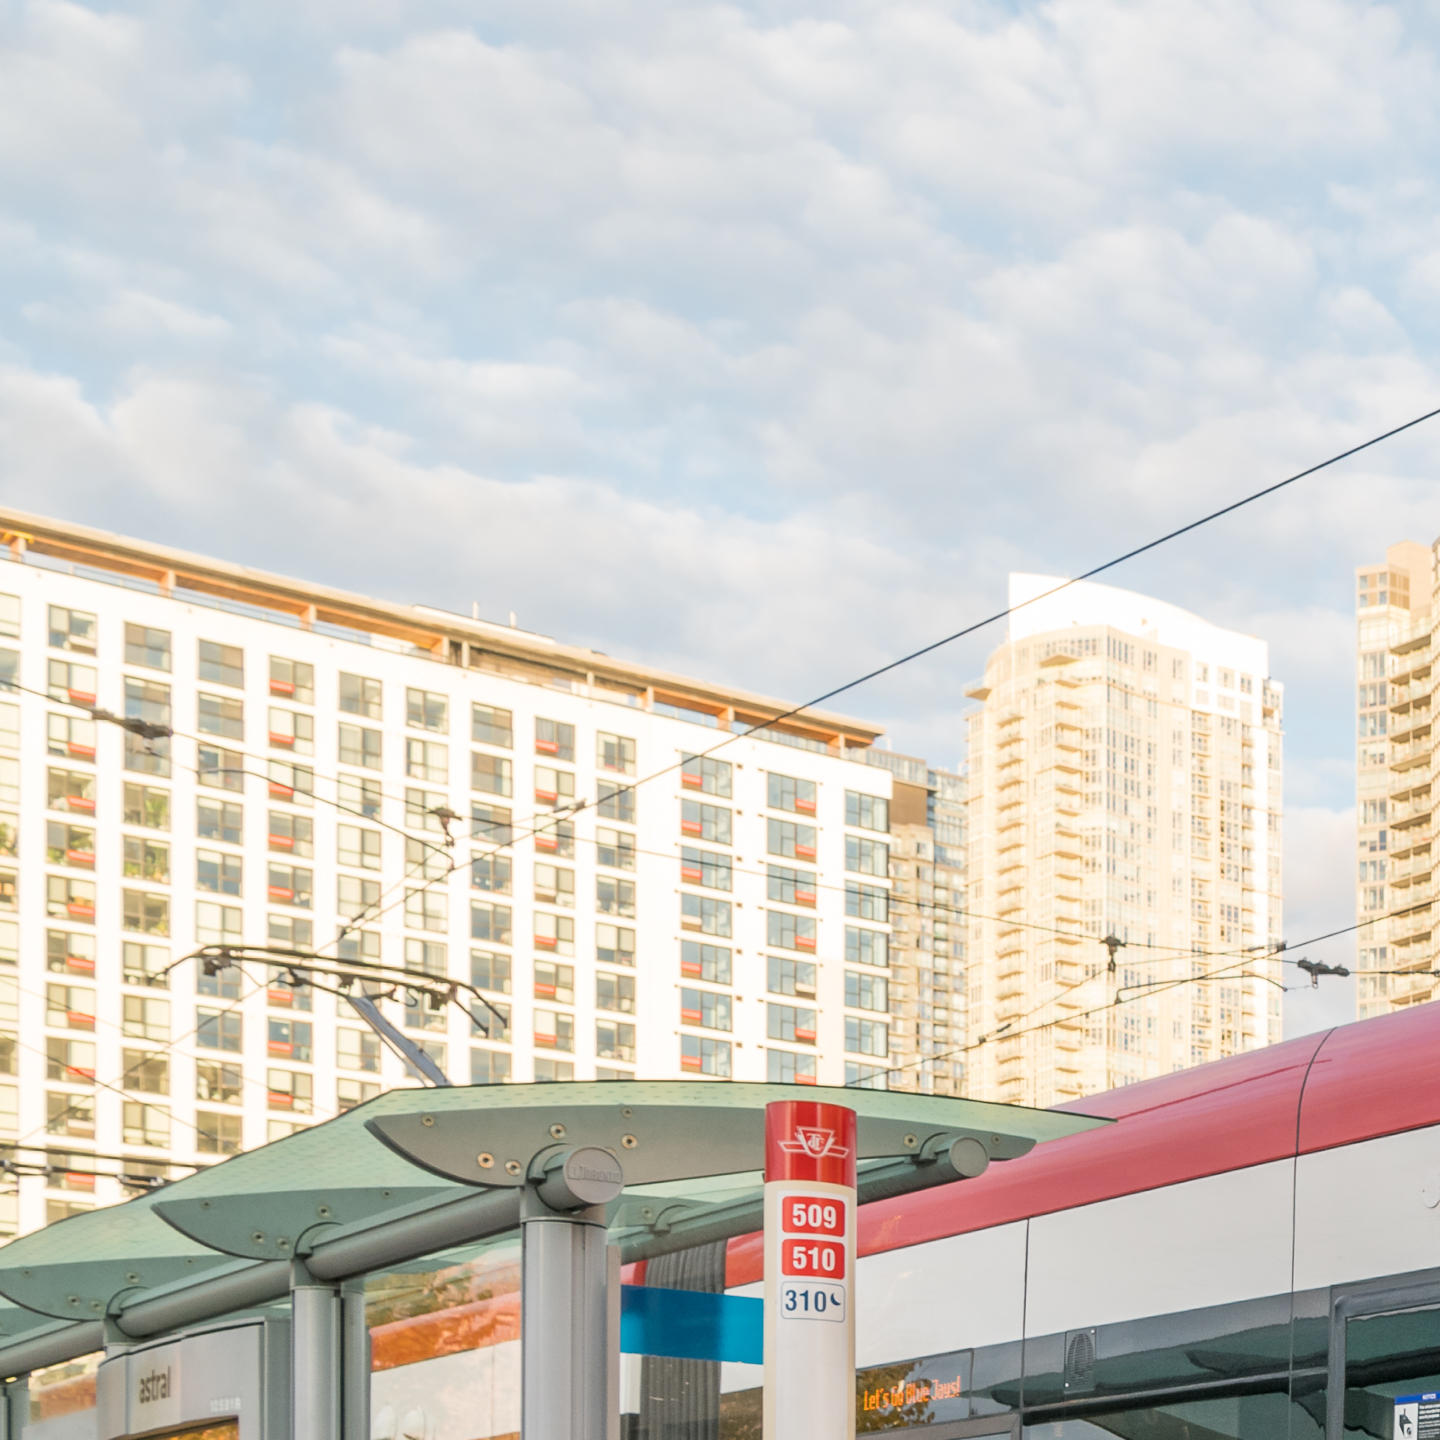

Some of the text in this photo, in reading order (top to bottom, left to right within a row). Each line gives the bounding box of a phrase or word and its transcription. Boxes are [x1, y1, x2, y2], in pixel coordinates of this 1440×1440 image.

[792, 1203, 837, 1229] 509
[792, 1246, 836, 1272] 510
[785, 1289, 827, 1312] 310
[140, 1366, 171, 1403] astral
[864, 1388, 890, 1411] Let's
[906, 1382, 930, 1404] Blue
[931, 1375, 961, 1401] Jays!
